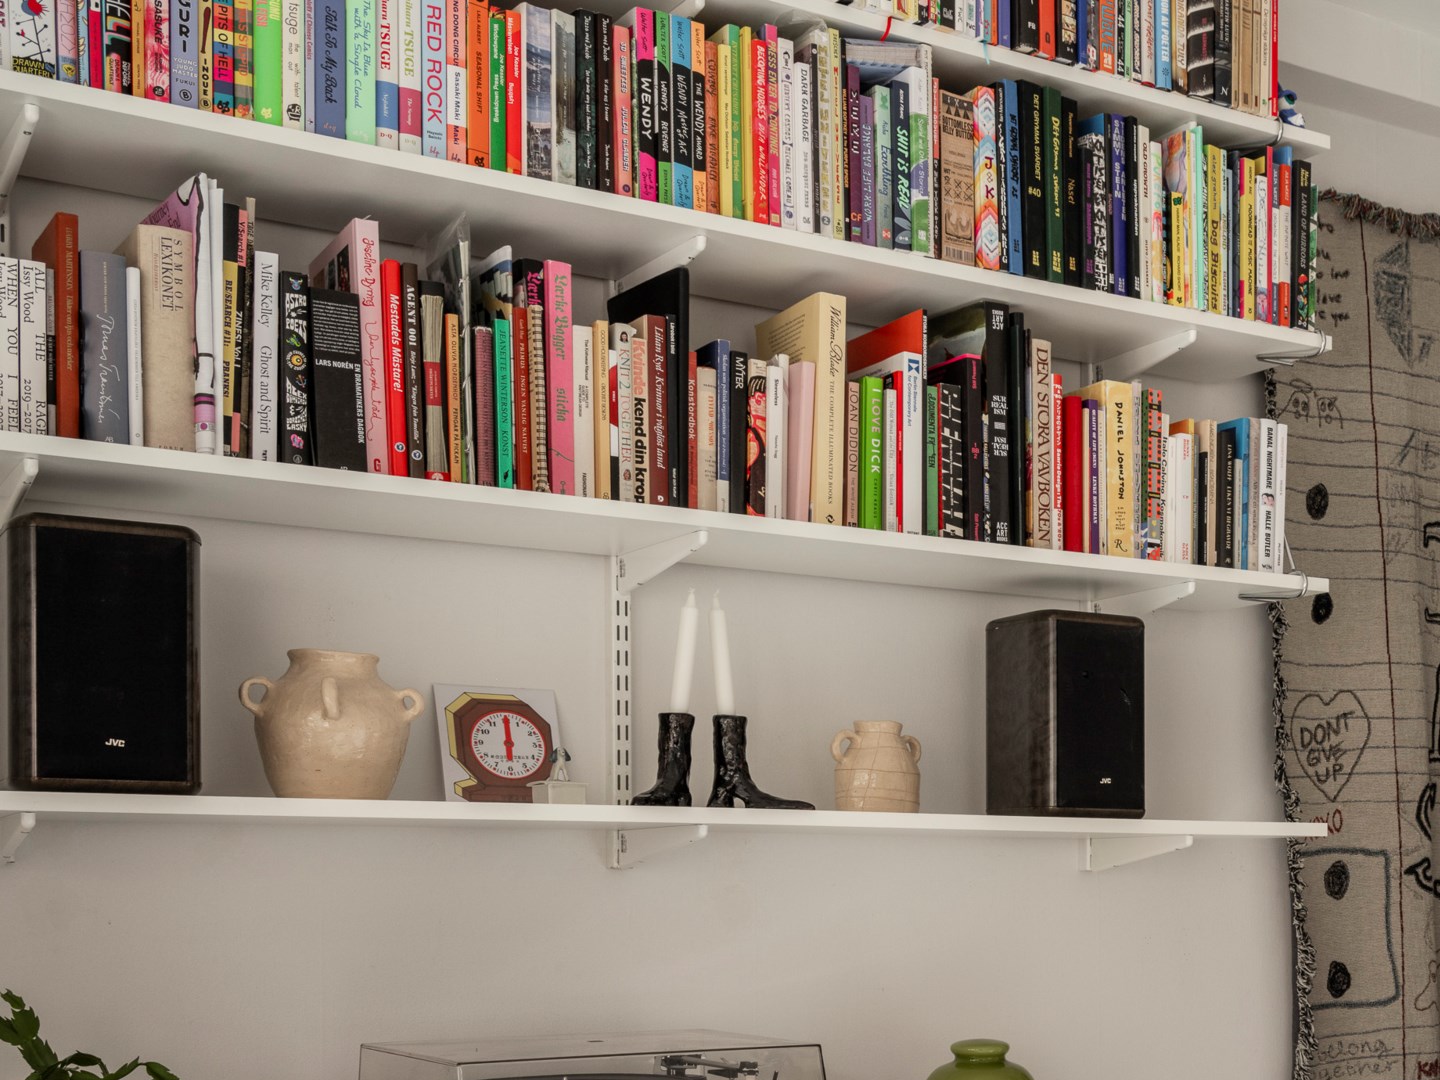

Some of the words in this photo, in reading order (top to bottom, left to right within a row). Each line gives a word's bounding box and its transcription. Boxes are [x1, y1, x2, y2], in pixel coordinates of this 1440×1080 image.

[325, 5, 337, 31] Talk
[354, 7, 362, 28] with
[360, 21, 371, 39] Sky
[426, 4, 442, 53] RED
[218, 33, 228, 51] OF
[380, 24, 391, 71] TSUGE
[404, 30, 414, 77] TSUGE
[768, 40, 777, 68] PRESS
[218, 52, 228, 79] HELL
[349, 42, 362, 77] Single
[363, 55, 371, 76] Blue
[757, 46, 766, 90] BECOMING
[325, 75, 337, 104] Back
[354, 78, 362, 109] Cloud
[426, 58, 443, 125] ROCK
[677, 73, 687, 106] WENDY
[768, 71, 777, 98] ENTER
[641, 77, 652, 141] WENDY
[694, 98, 704, 135] WENDY
[757, 92, 767, 120] HORSES
[802, 98, 810, 142] GARBAGE
[768, 114, 778, 156] CONTINUE
[897, 126, 909, 157] SHIT
[880, 145, 890, 196] Earthling
[898, 174, 910, 209] REAL
[985, 185, 994, 199] K
[1029, 187, 1041, 197] #40
[1210, 219, 1218, 247] Dog
[1301, 218, 1307, 229] OF
[7, 263, 18, 308] WHEN
[21, 266, 34, 288] Issy
[34, 267, 46, 294] ALL
[161, 236, 174, 311] LEXIKONET
[261, 262, 273, 291] Mike
[23, 291, 34, 323] Wood
[261, 294, 273, 328] Kelley
[285, 293, 307, 311] ASTRO
[406, 285, 417, 325] AGENT
[286, 320, 307, 343] POETS
[389, 294, 401, 345] Mestadels
[829, 305, 842, 341] William
[7, 327, 18, 356] YOU
[35, 332, 46, 361] THE
[408, 328, 417, 346] 001
[499, 329, 507, 371] JEANETTE
[655, 326, 665, 352] Lilian
[260, 345, 273, 376] Ghost
[315, 359, 332, 368] LARS
[332, 360, 354, 370] NORÉN
[391, 346, 403, 393] Mästare!
[619, 348, 630, 379] KNIT
[633, 340, 646, 395] Kvinde
[653, 353, 664, 372] Ryd
[830, 341, 843, 378] Blake
[1037, 347, 1049, 387] DEN
[260, 380, 270, 400] and
[354, 370, 363, 417] DRAMATIKERS
[500, 374, 508, 424] WINTERSON
[655, 375, 665, 413] Kvinnor
[849, 388, 858, 422] JOAN
[7, 398, 18, 433] FEEL
[35, 400, 46, 435] RAGE
[259, 402, 272, 434] Spirit
[633, 397, 647, 438] kend
[688, 379, 696, 440] Konstordbok
[871, 398, 880, 433] LOVE
[1037, 392, 1050, 448] STORA
[1114, 402, 1124, 443] DANIEL
[357, 418, 365, 443] DAGBOK
[501, 430, 509, 458] KONST
[620, 394, 631, 463] TOGETHER
[654, 419, 665, 447] väglöst
[633, 439, 647, 466] din
[656, 448, 665, 470] land
[849, 426, 858, 473] DIDION
[871, 438, 880, 473] DICK
[631, 467, 647, 503] krop
[1117, 450, 1125, 500] JOHNSTON
[1265, 450, 1273, 489] NIGHTMARE
[996, 522, 1008, 530] ACC
[996, 529, 1008, 537] ART
[105, 738, 125, 747] JVC
[1300, 711, 1356, 752] DONT
[1314, 762, 1345, 787] UP
